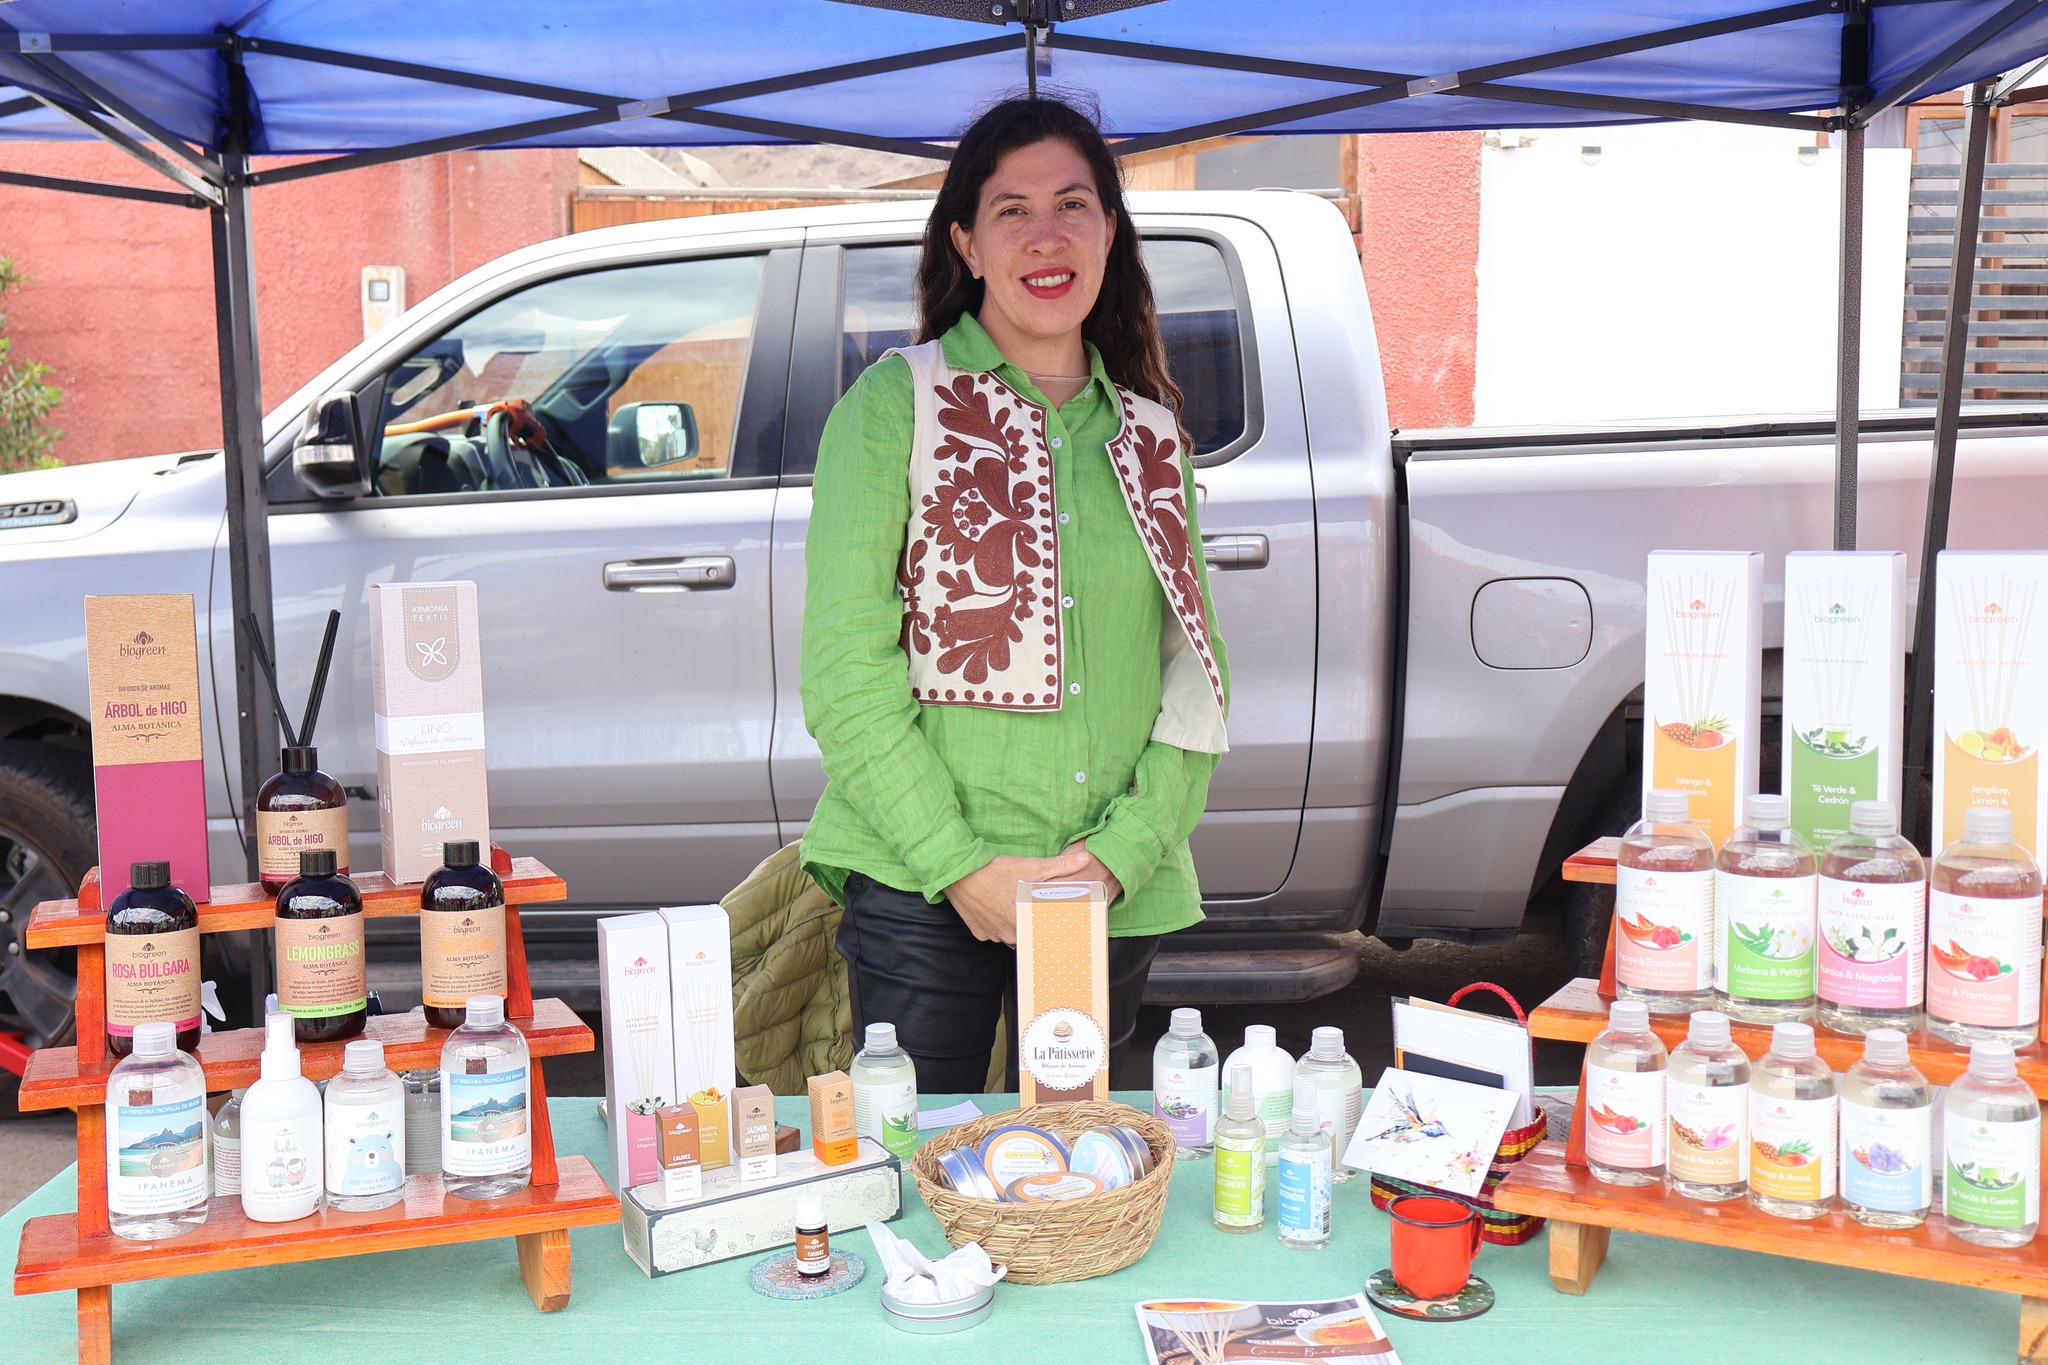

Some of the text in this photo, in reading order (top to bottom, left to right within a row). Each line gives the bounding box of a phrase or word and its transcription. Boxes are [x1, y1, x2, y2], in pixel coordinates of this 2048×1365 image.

[411, 604, 448, 612] ARMONÍA
[1676, 610, 1719, 620] biogreen
[1814, 614, 1860, 624] biogreen
[1969, 614, 2018, 624] biogreen
[120, 643, 166, 659] biogreen
[105, 701, 187, 718] ÁRBOL de HIGO
[138, 721, 181, 730] BOTÁNICA
[421, 722, 452, 735] LINO
[400, 736, 472, 747] Difusor de Aromas
[1676, 777, 1704, 786] Mango
[1682, 788, 1706, 796] Ananá
[1812, 784, 1856, 794] Té Verde &
[1970, 786, 2010, 796] Jengibre,
[1818, 795, 1849, 805] Cedrón
[1972, 797, 1999, 805] Limón
[421, 818, 462, 833] biogreen
[268, 833, 323, 845] ÁRBOL de HIGO
[1634, 885, 1668, 894] biogreen
[1842, 895, 1873, 907] biogreen
[1846, 913, 1895, 921] ESENCIALES
[1948, 910, 1986, 921] biogreen
[454, 926, 480, 935] biogreen
[1955, 928, 2005, 937] ESENCIALES
[132, 951, 167, 959] biogreen
[286, 941, 361, 961] LEMONGRASS
[686, 958, 716, 968] biogreen
[1647, 959, 1691, 967] Frambuesa
[112, 959, 190, 979] ROSA BÚLGARA
[624, 966, 656, 977] biogreen
[1734, 964, 1777, 976] Verbena &
[1855, 972, 1902, 983] Magnolias
[1952, 988, 1959, 996] &
[1961, 990, 2011, 1001] Frambuesa
[1034, 1046, 1095, 1060] La Pâtisserie
[156, 1106, 180, 1114] TROPICAL
[189, 1100, 200, 1109] BRASIL
[831, 1109, 849, 1119] TANGE
[356, 1119, 389, 1128] biogreen
[668, 1128, 693, 1136] biogreen
[746, 1124, 768, 1135] JAZMÍN
[754, 1133, 769, 1142] CABO
[274, 1140, 298, 1153] bebé
[1612, 1140, 1649, 1148] Frambuesa
[466, 1144, 516, 1155] IPANEMA
[672, 1153, 691, 1161] CALIDEZ
[152, 1162, 177, 1170] biogreen
[1755, 1166, 1777, 1178] Mango
[1786, 1173, 1811, 1181] Ananá
[138, 1177, 193, 1191] IPANEMA
[1217, 1178, 1247, 1189] AUTOMÓVIL
[1280, 1188, 1306, 1202] AUTOMÓVIL
[1958, 1191, 1979, 1202] Verde
[1989, 1196, 2018, 1205] Cedrón
[1266, 1317, 1350, 1326] biogreen
